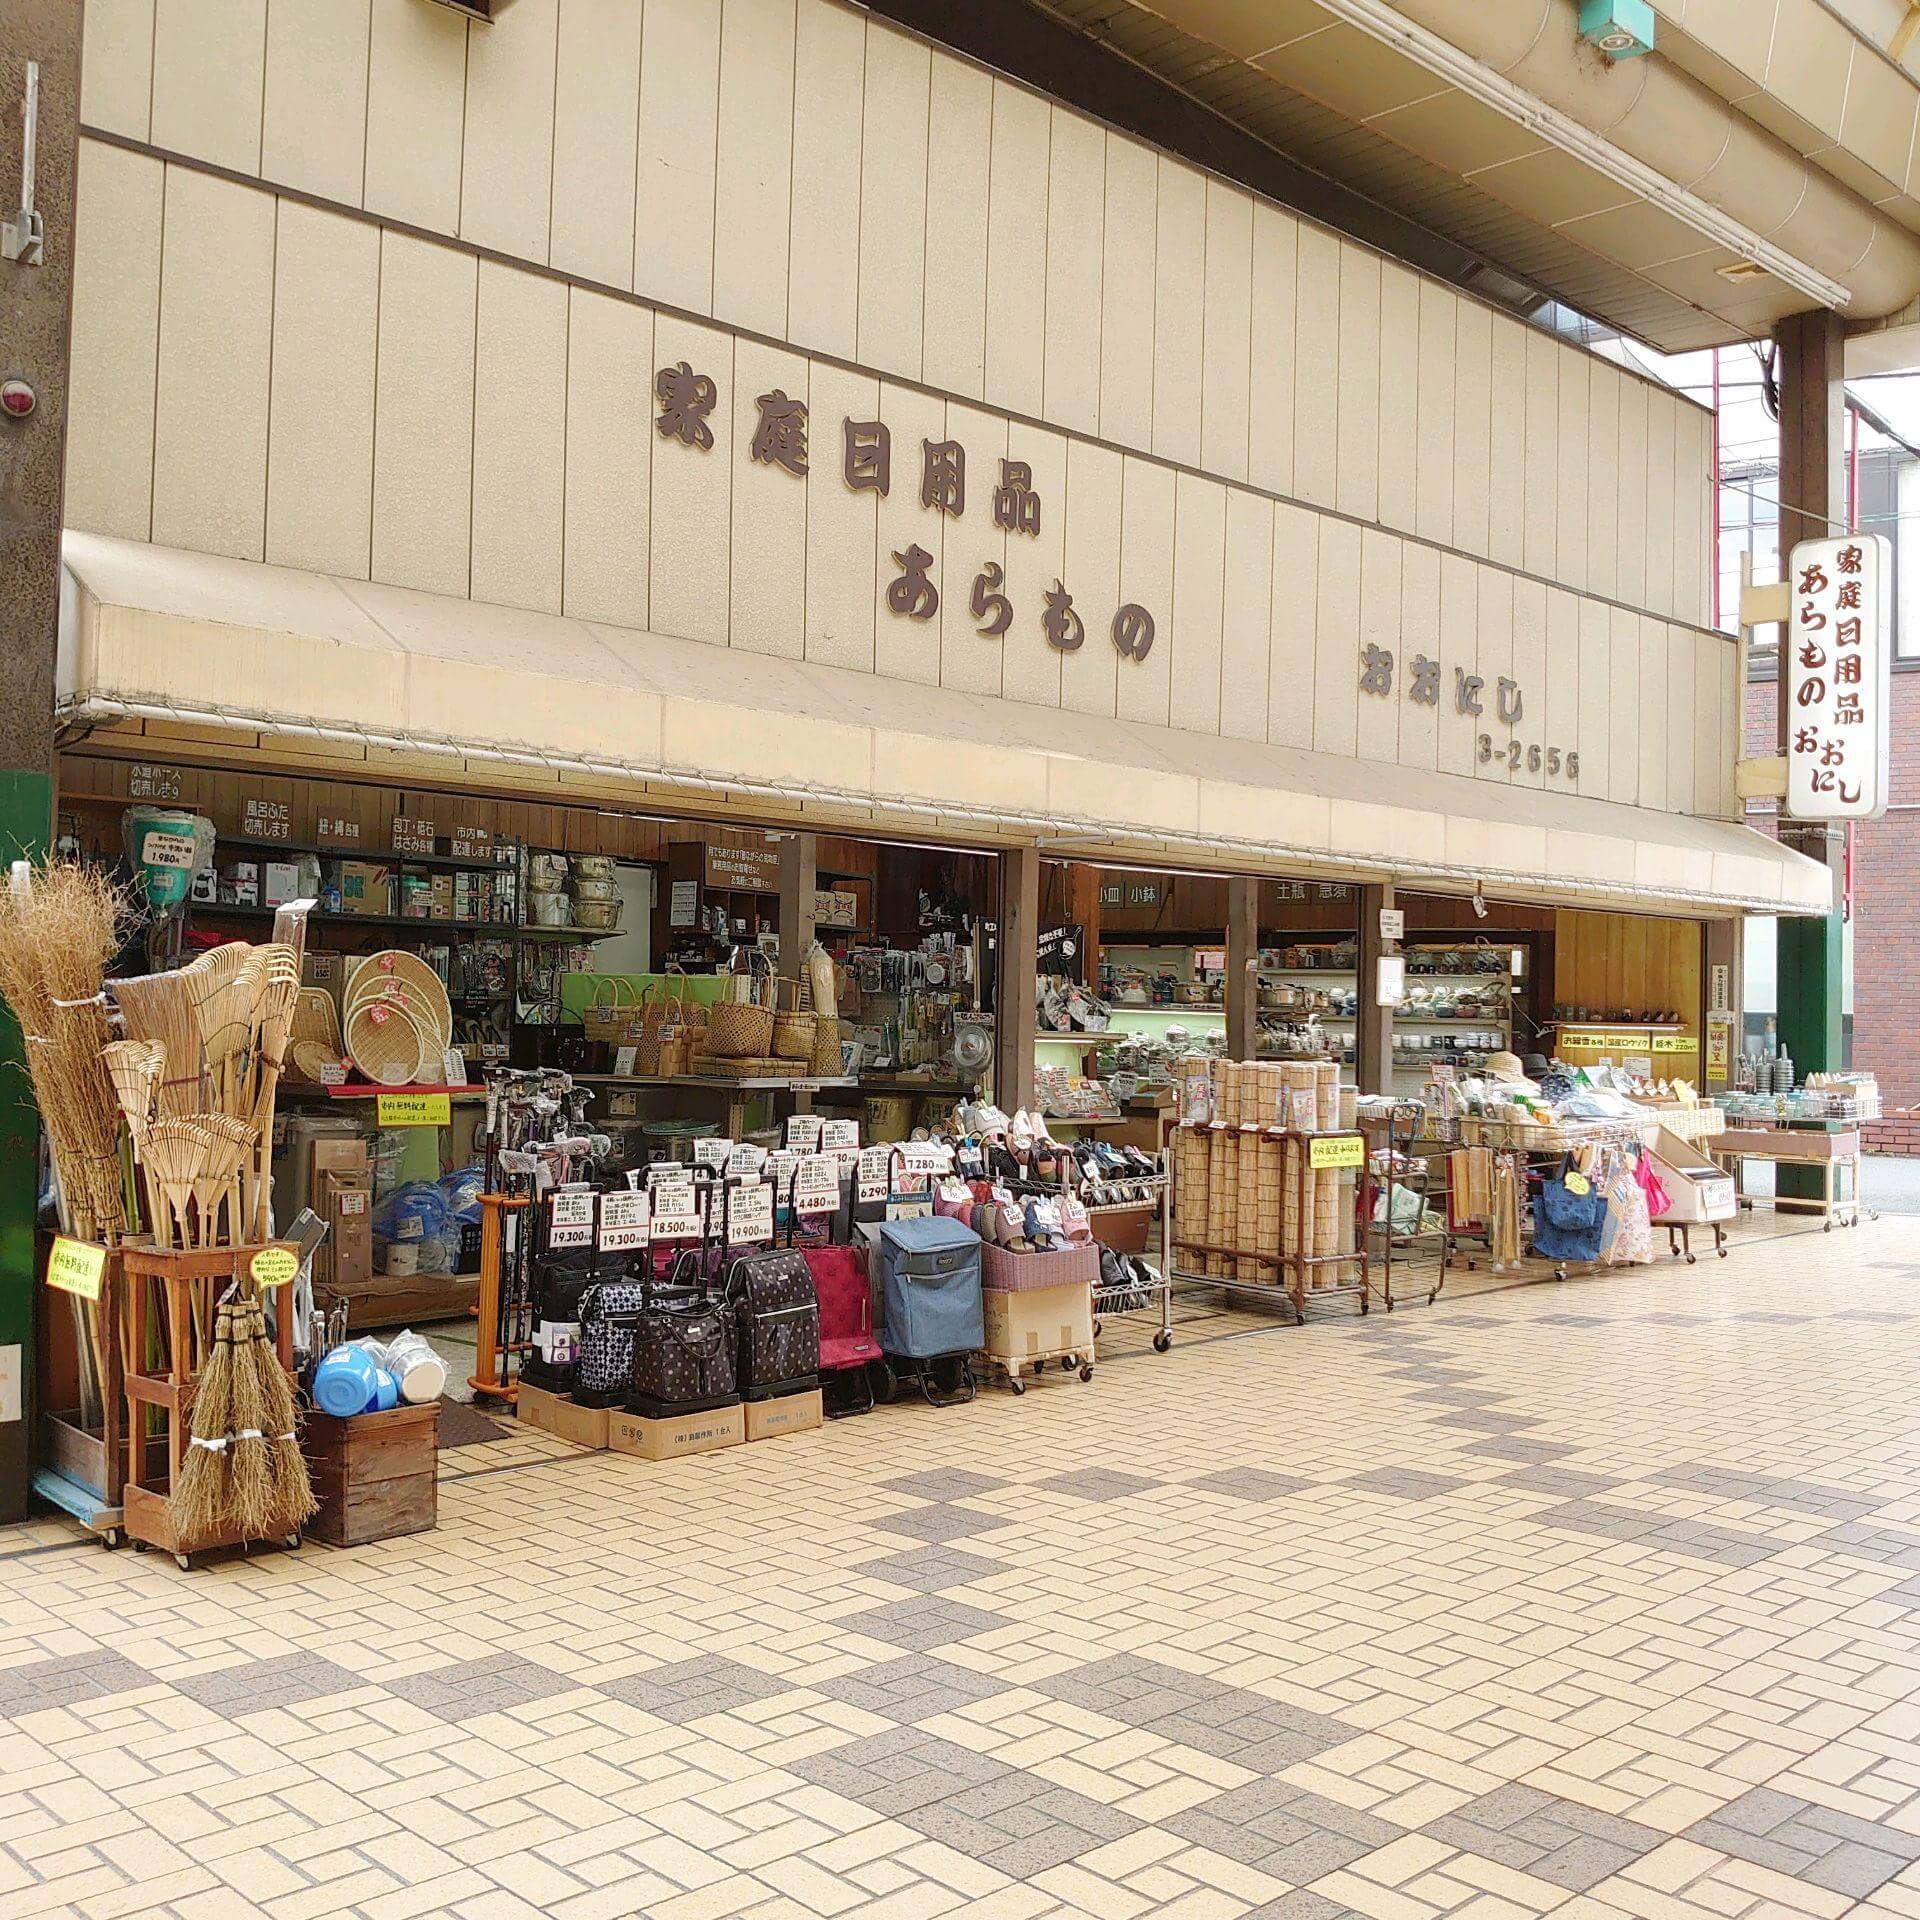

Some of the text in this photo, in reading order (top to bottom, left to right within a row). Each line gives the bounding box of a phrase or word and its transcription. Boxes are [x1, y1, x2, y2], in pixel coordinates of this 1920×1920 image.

[656, 361, 1041, 537] 家庭日用品
[886, 542, 1156, 663] あらもの
[1797, 564, 1829, 706] あらもの
[1834, 544, 1864, 726] 家庭日用品
[1359, 643, 1523, 724] おおにし
[1477, 733, 1579, 779] 3-2656
[246, 800, 289, 820] 風呂ふた
[244, 818, 290, 839] 切売します
[392, 817, 435, 837] 包丁・砥石
[456, 826, 476, 839] 市内
[392, 834, 434, 853] はさみ各種
[452, 840, 492, 858] 配達します
[1131, 887, 1156, 903] 小鉢
